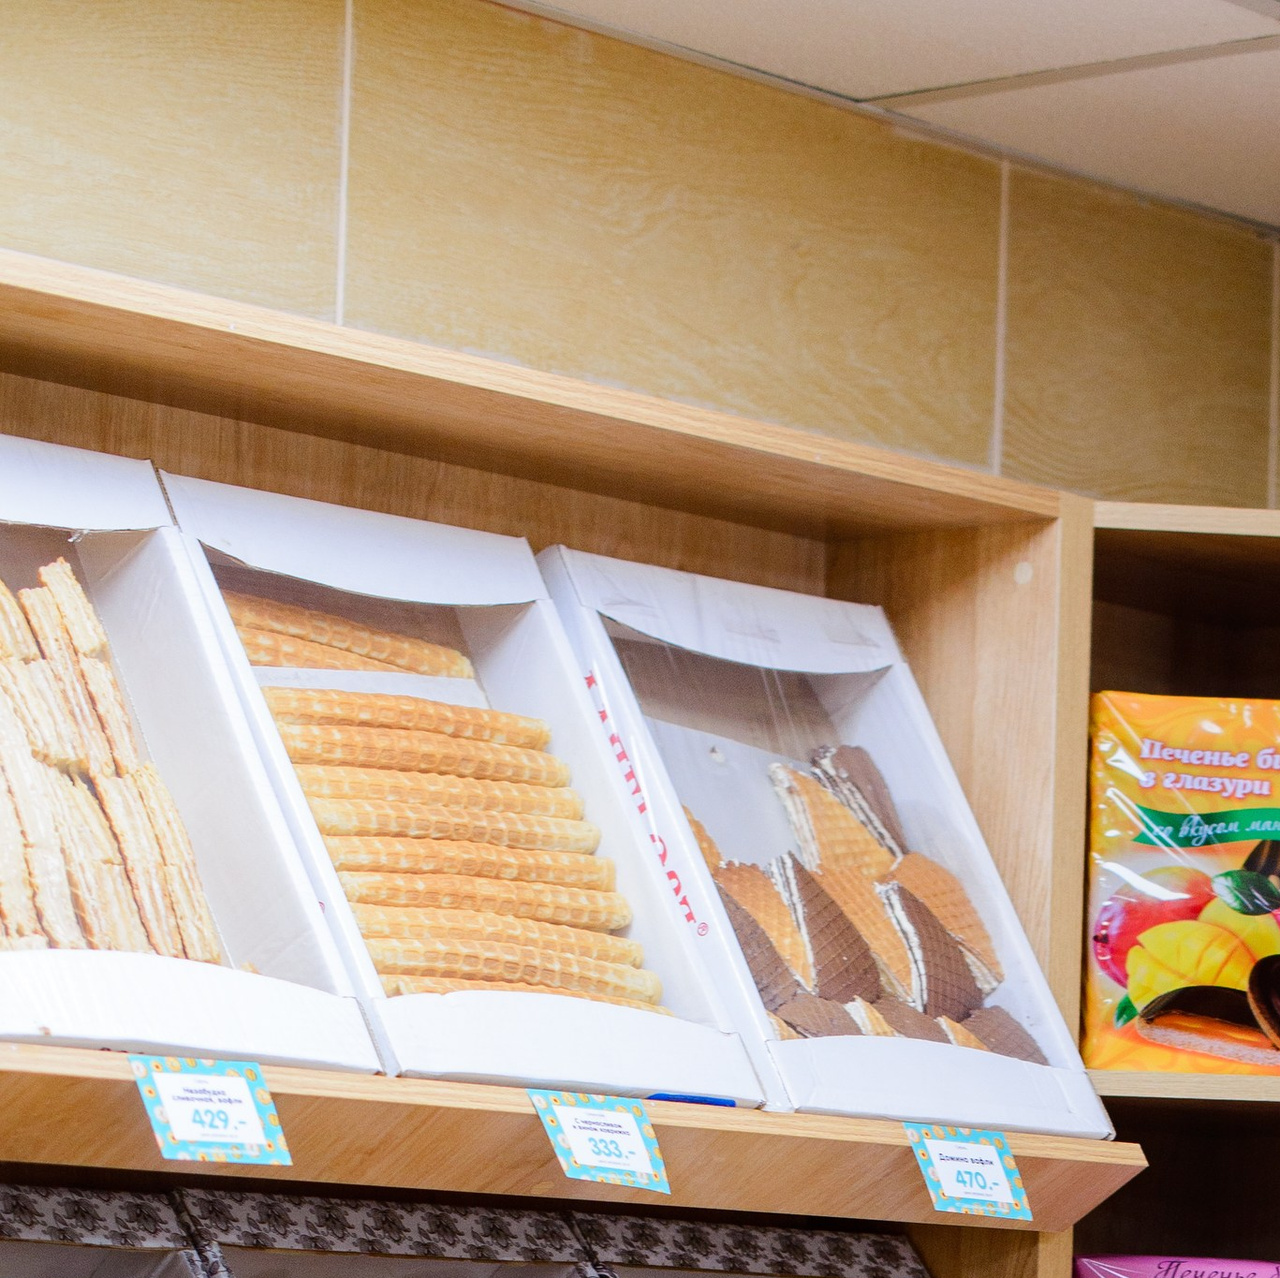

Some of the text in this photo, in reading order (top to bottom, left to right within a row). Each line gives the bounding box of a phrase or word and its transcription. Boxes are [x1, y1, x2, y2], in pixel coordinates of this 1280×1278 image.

[1140, 738, 1250, 768] Печенье
[1162, 772, 1271, 798] глазури
[1178, 815, 1239, 846] вкусом
[192, 1108, 247, 1131] 429.-
[588, 1137, 636, 1159] 333.-
[956, 1170, 999, 1190] 470.-
